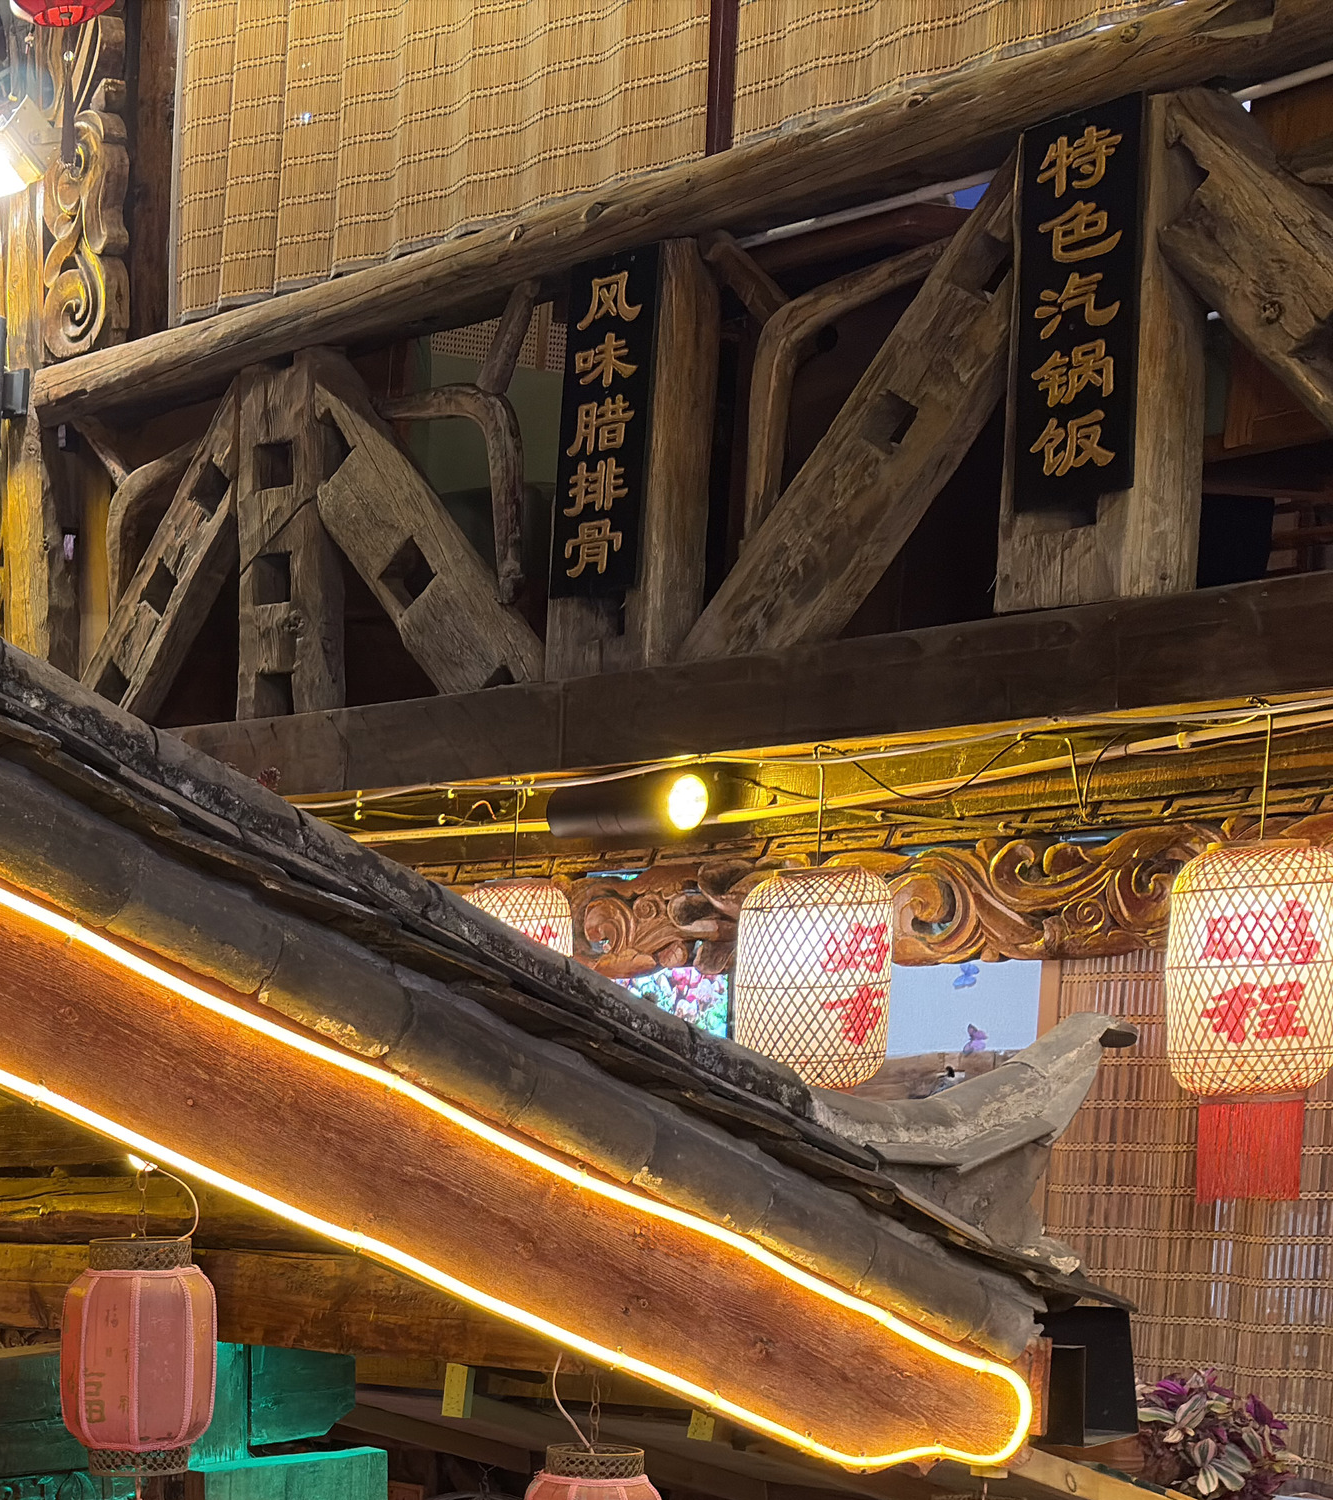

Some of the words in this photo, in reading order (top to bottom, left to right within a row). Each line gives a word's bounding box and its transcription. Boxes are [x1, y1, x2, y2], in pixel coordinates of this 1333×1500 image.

[564, 271, 642, 578] 风味腊排骨
[1029, 124, 1124, 478] 特色汽锅饭
